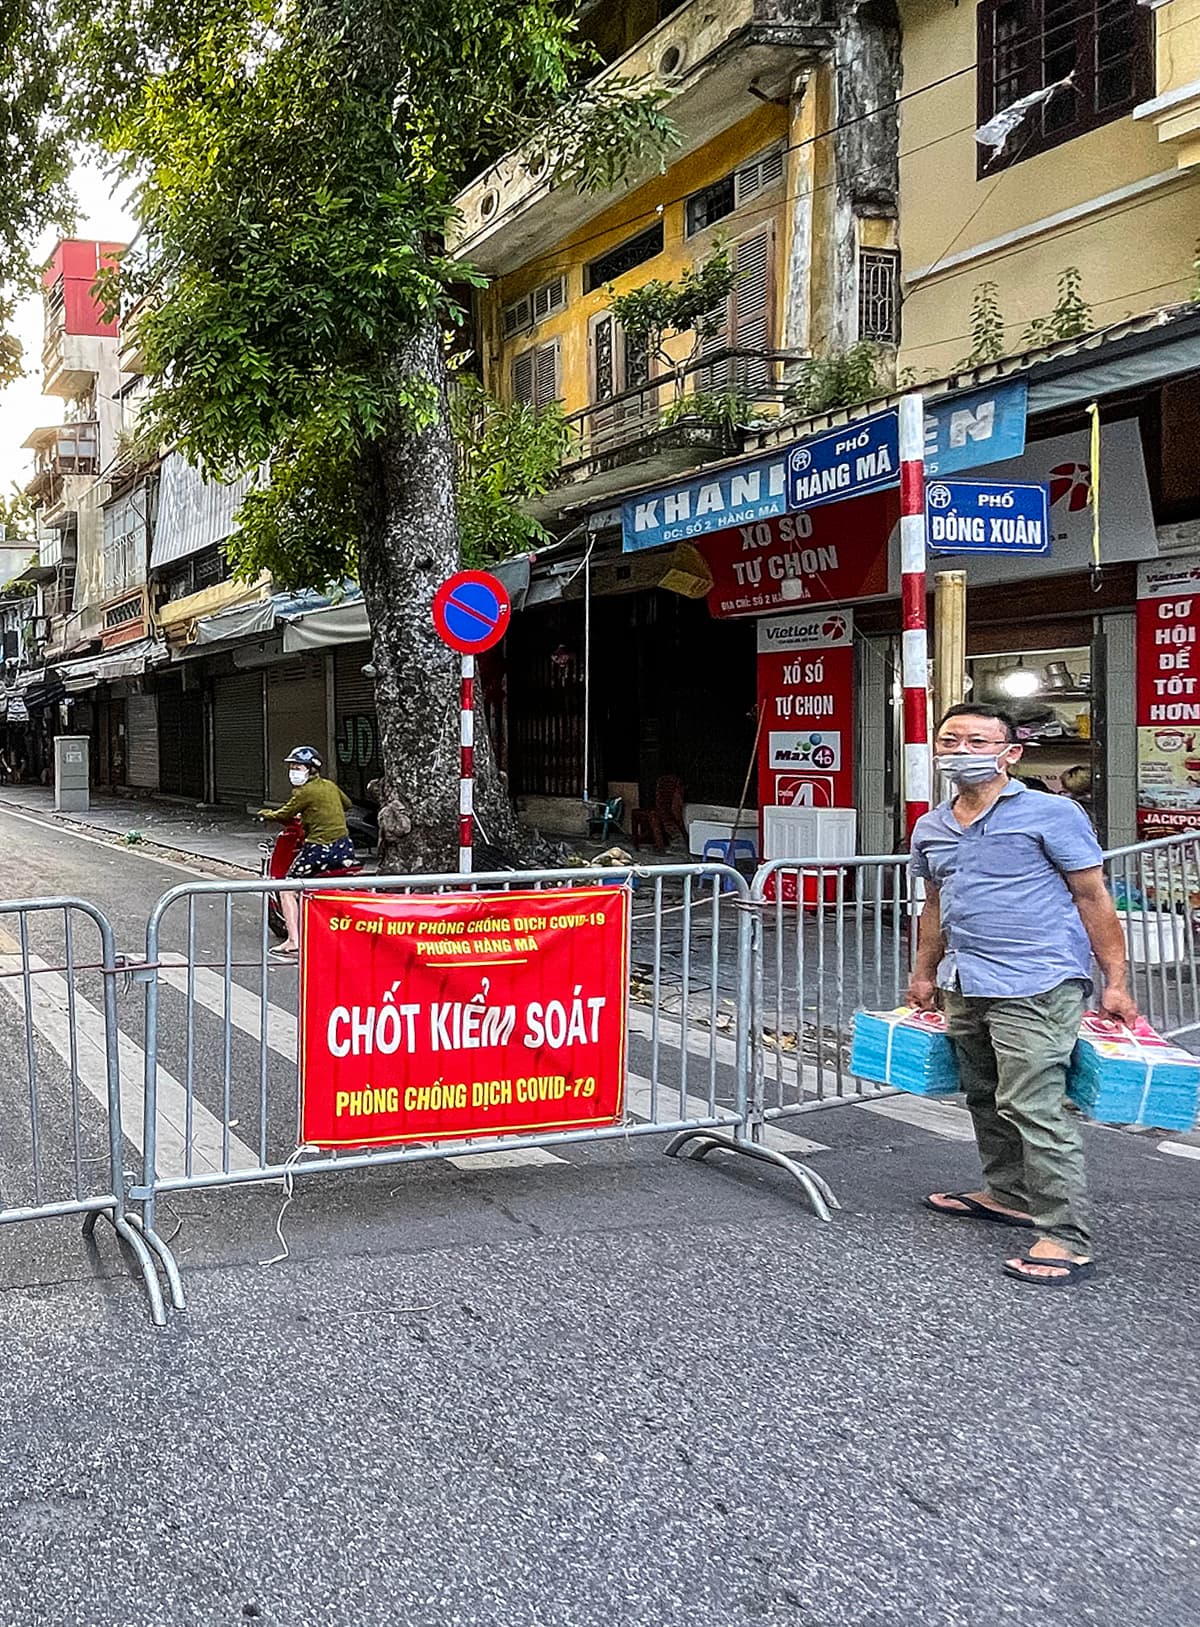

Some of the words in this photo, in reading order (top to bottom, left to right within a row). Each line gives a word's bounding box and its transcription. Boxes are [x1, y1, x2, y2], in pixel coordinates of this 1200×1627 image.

[835, 428, 870, 455] PHỐ
[796, 463, 851, 501] HÀNG
[856, 444, 892, 482] MÃ
[978, 491, 1014, 508] PHỐ
[705, 521, 712, 530] 2
[718, 509, 754, 527] HÀNG
[932, 508, 985, 542] ĐỒNG
[990, 515, 1041, 545] XUÂN
[733, 557, 762, 587] TỰ
[768, 545, 839, 579] CHỌN
[765, 594, 771, 604] 2
[1158, 600, 1193, 619] CƠ
[766, 624, 819, 640] Vietlott
[1155, 624, 1196, 647] HỘI
[1159, 646, 1192, 670] ĐỂ
[783, 656, 801, 685] XỔ
[805, 656, 824, 683] SỐ
[1153, 673, 1198, 695] TỐT
[775, 695, 793, 719] TỰ
[796, 695, 834, 719] CHỌN
[1150, 702, 1200, 721] HƠN
[775, 750, 811, 761] Max
[329, 915, 352, 931] SỞ
[355, 917, 384, 934] CHỈ
[387, 921, 415, 935] HUY
[418, 919, 464, 935] PHÒNG
[467, 915, 510, 933] CHỐNG
[514, 917, 546, 933] DỊCH
[550, 912, 605, 928] COVID-19
[417, 938, 471, 955] PHƯỜNG
[474, 937, 512, 953] HÀNG
[514, 935, 538, 951] MÃ
[327, 981, 420, 1058] CHỐT
[431, 977, 517, 1050] KIỂM
[524, 984, 606, 1049] SOÁT
[336, 1086, 399, 1118] PHÒNG
[404, 1078, 467, 1111] CHỐNG
[472, 1081, 512, 1111] DỊCH
[516, 1077, 595, 1103] COVID-19
